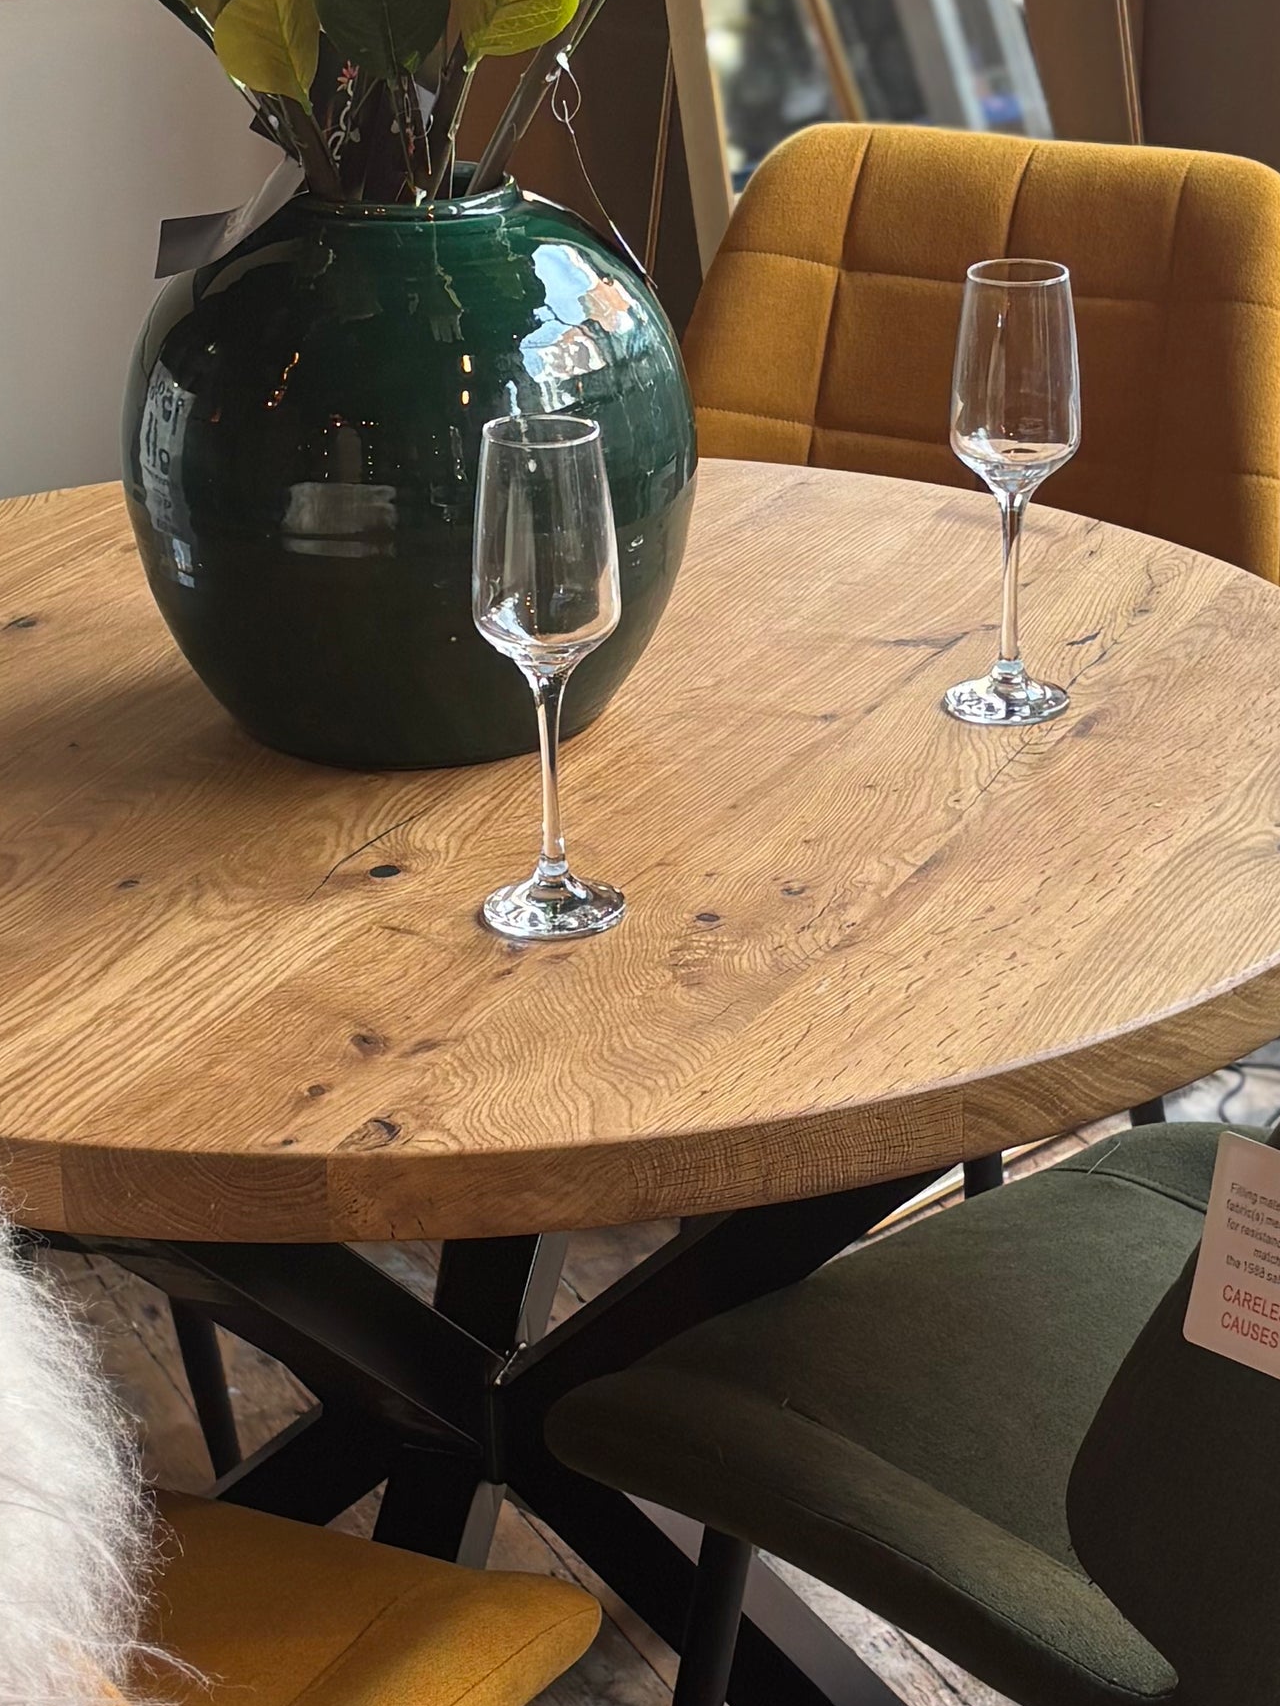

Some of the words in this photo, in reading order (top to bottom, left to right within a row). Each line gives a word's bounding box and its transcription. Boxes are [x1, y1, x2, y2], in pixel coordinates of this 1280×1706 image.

[1230, 1182, 1258, 1204] Filling
[1227, 1199, 1264, 1225] fabric(s)
[1227, 1218, 1238, 1230] for
[1226, 1254, 1240, 1269] the
[1253, 1249, 1280, 1267] match
[1221, 1312, 1279, 1348] CAUSES
